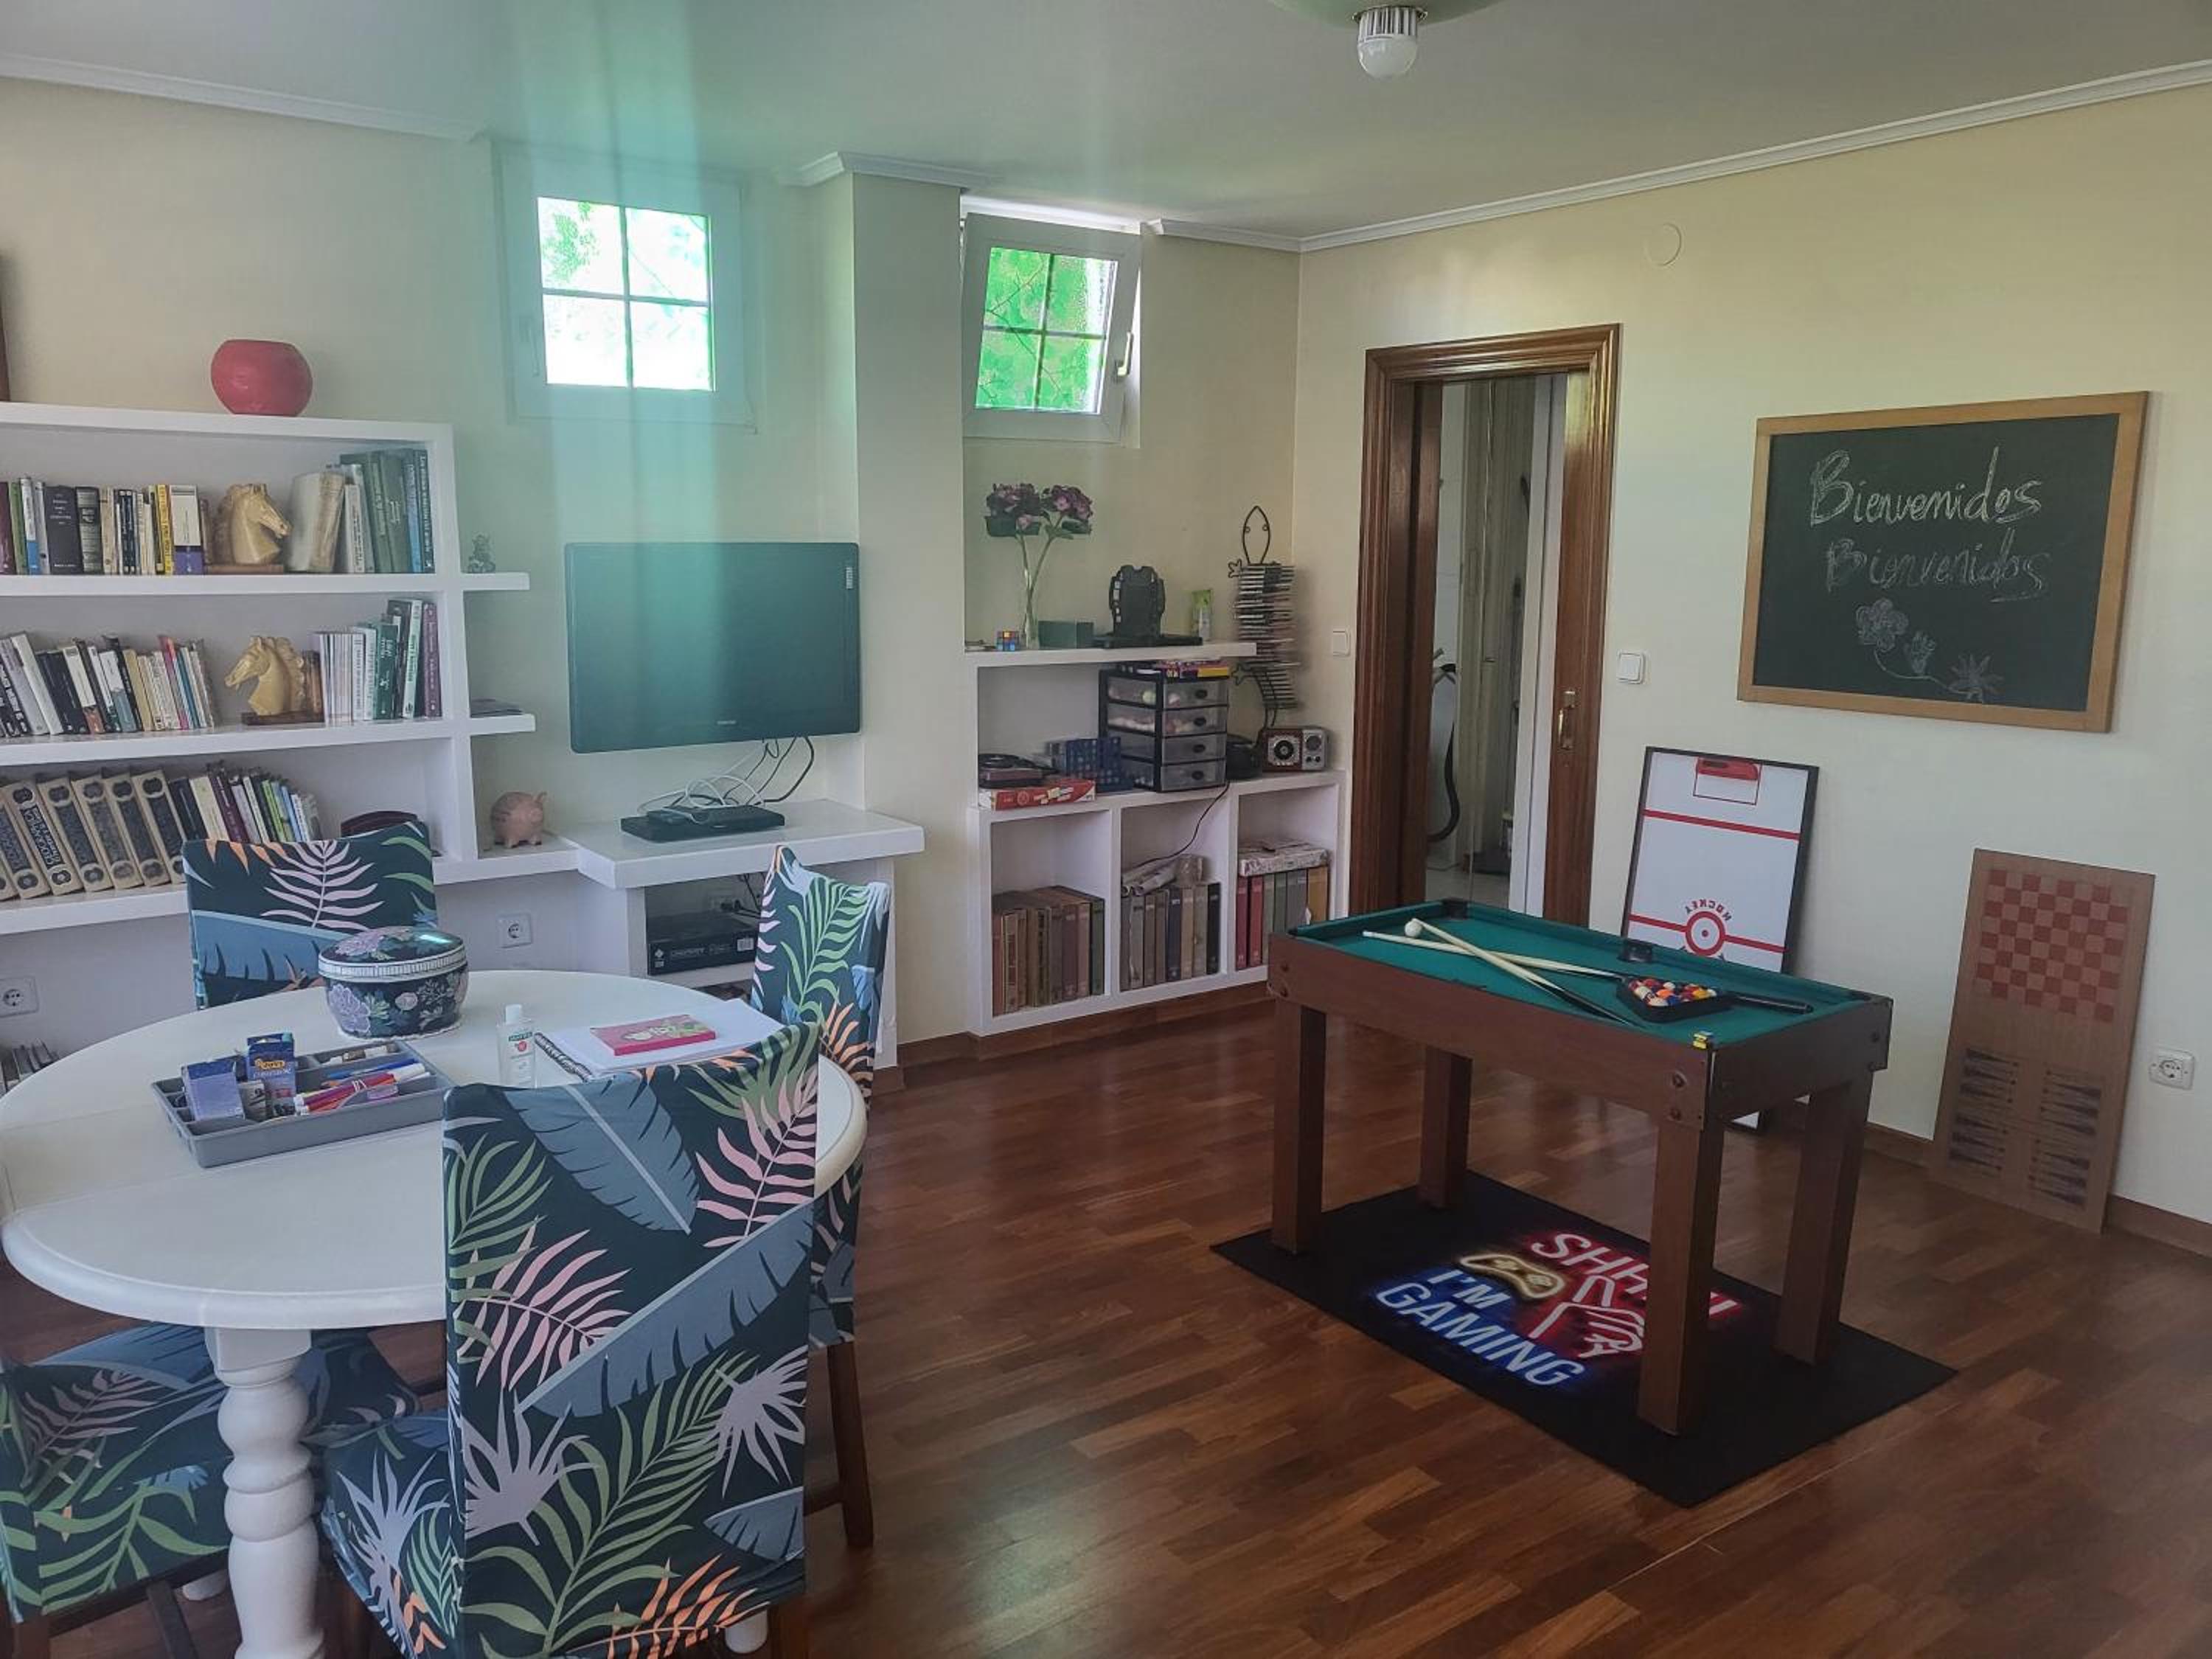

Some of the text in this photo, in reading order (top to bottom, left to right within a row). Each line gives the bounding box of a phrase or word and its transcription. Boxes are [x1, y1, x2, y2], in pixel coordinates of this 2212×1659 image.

[1809, 445, 2042, 526] Bienvenidos
[1685, 899, 1732, 922] HOCKEY
[1426, 1269, 1511, 1310] I'M
[1377, 1282, 1585, 1385] GAMING
